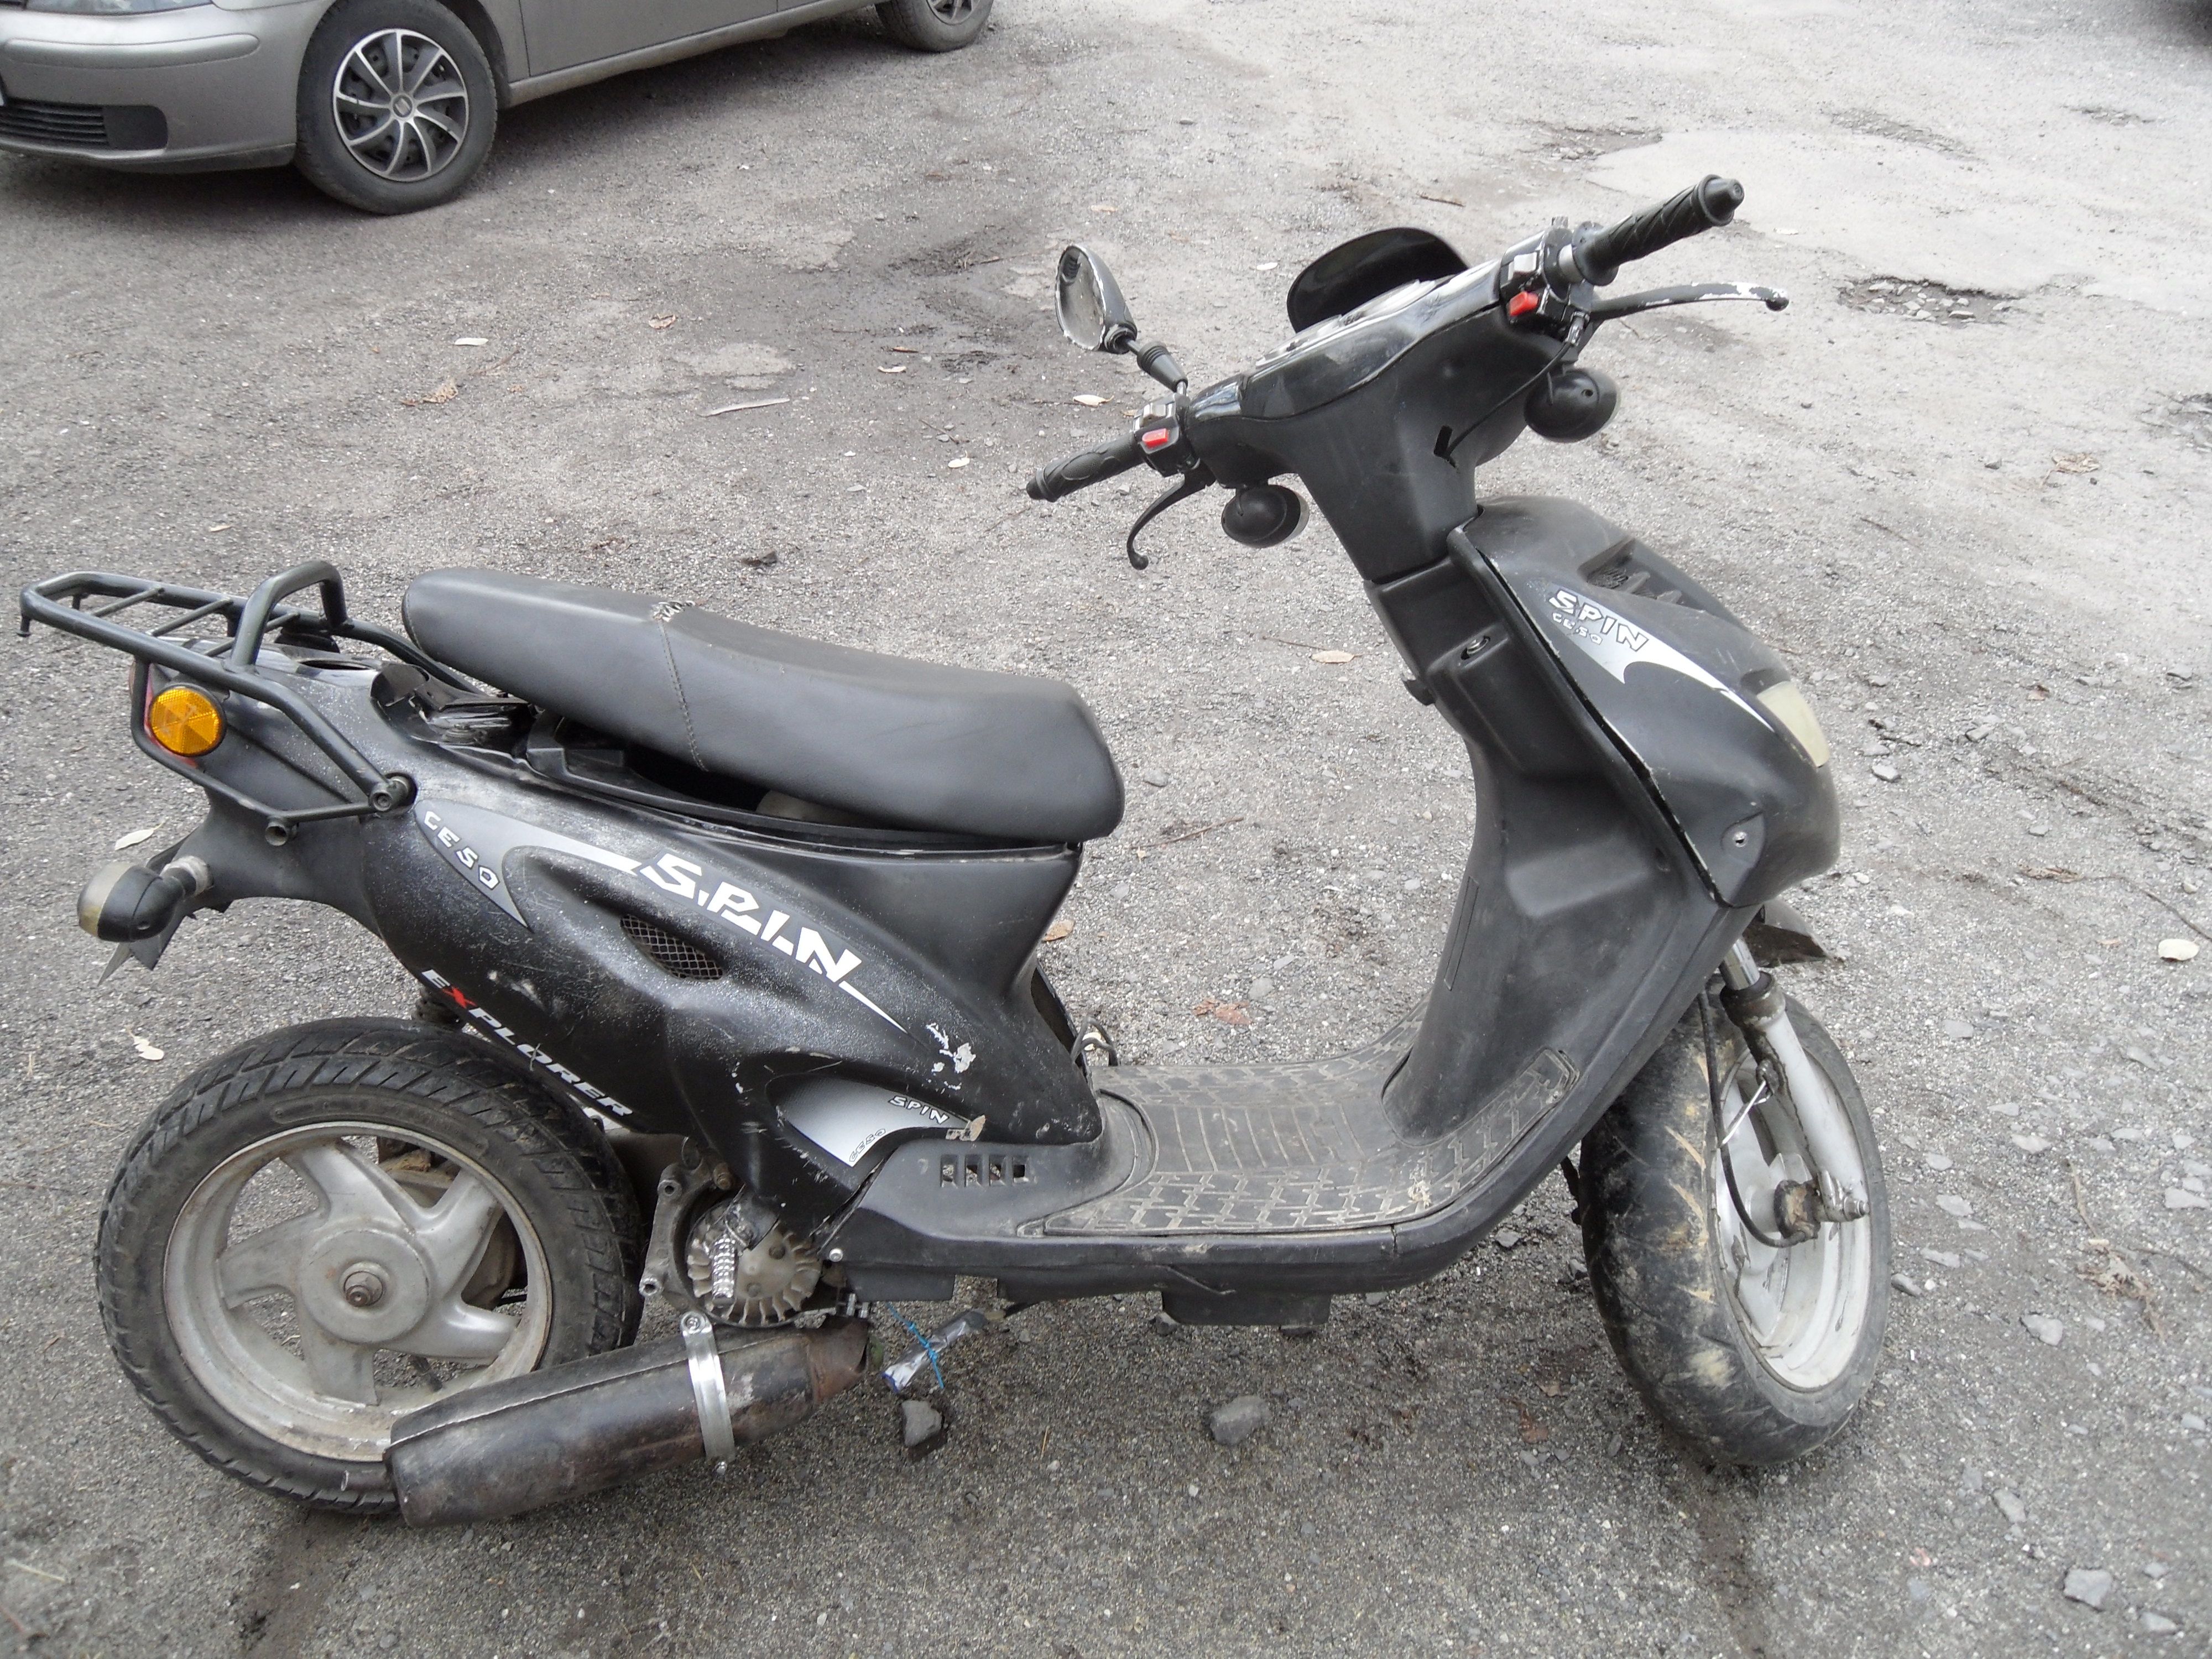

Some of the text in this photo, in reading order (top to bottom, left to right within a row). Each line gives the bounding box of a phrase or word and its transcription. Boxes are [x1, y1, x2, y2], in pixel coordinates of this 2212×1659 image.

[1549, 589, 1649, 651] SPIN
[421, 969, 633, 1116] EXPLORER
[888, 1095, 950, 1125] SPIN
